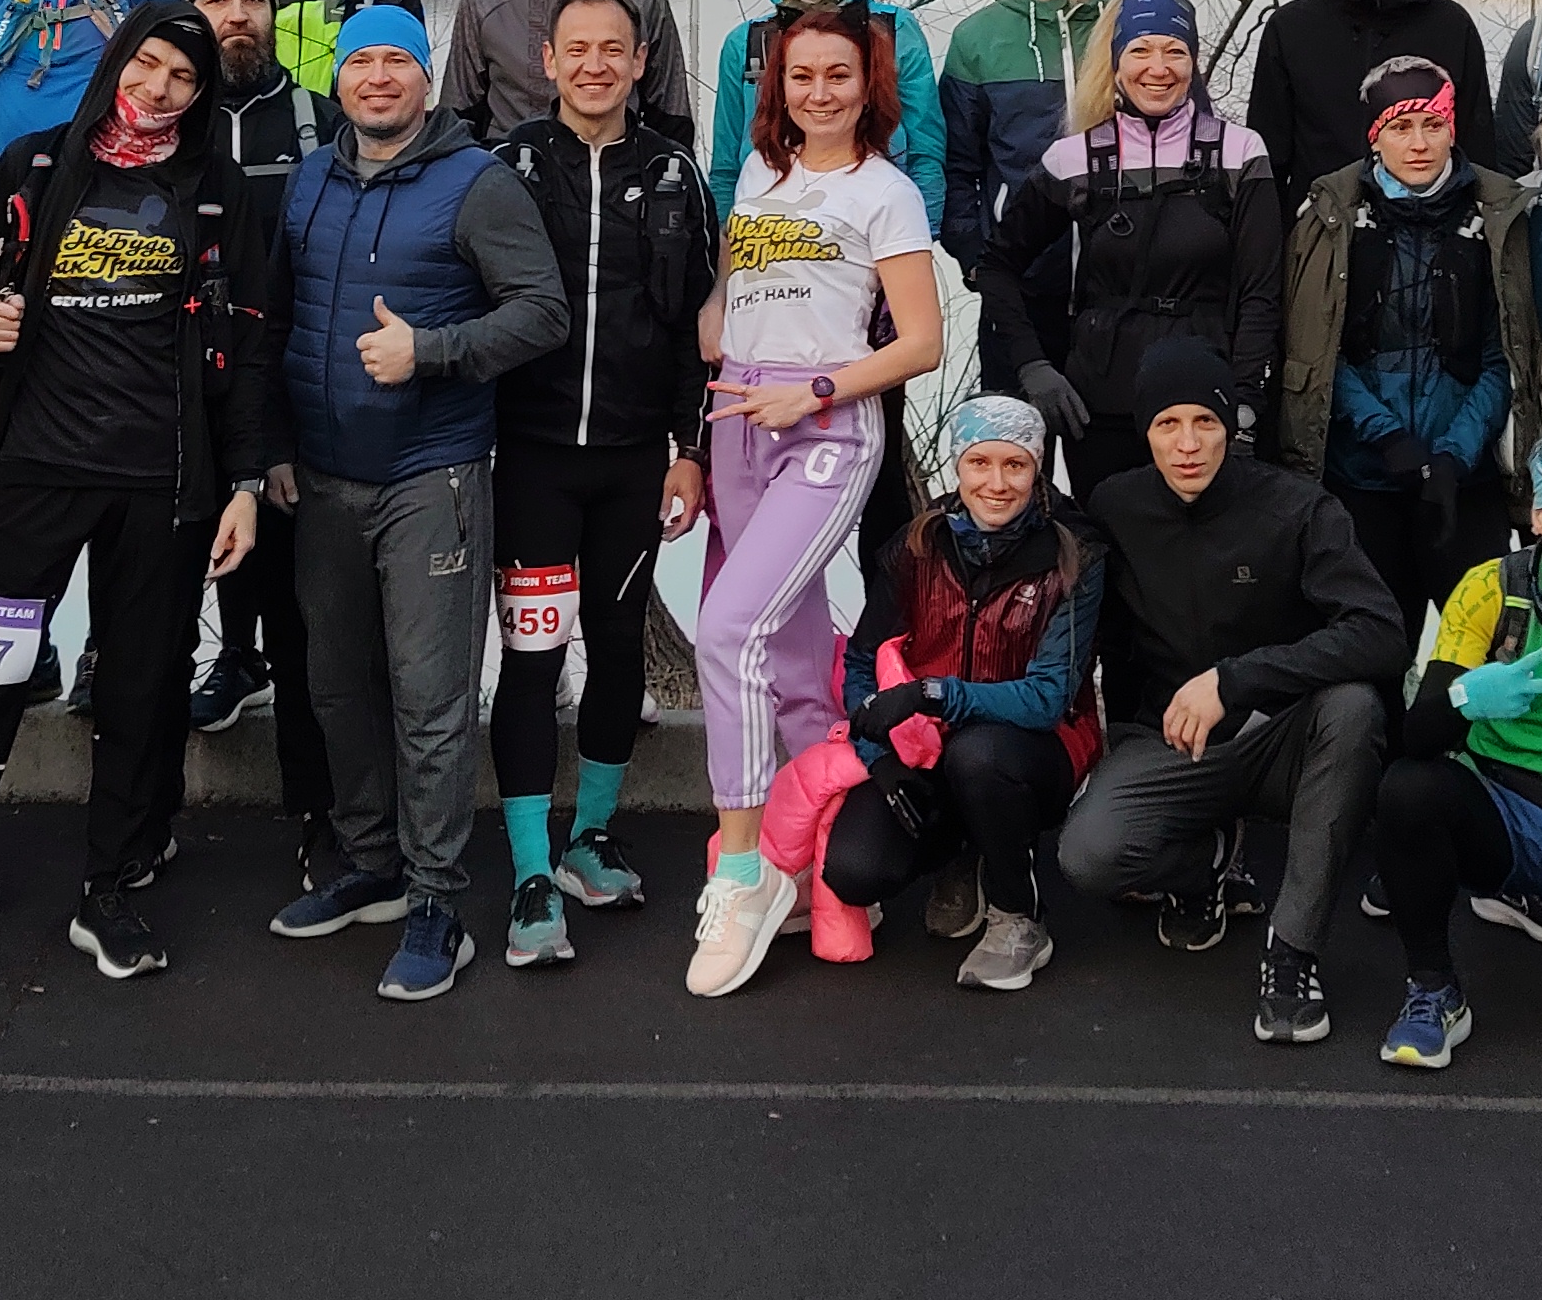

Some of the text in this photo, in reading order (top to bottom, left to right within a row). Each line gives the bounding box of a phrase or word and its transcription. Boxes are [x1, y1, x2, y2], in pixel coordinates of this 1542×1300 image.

[764, 287, 812, 301] НАМИ
[510, 572, 572, 587] IRON TEAM
[502, 605, 560, 637] 459
